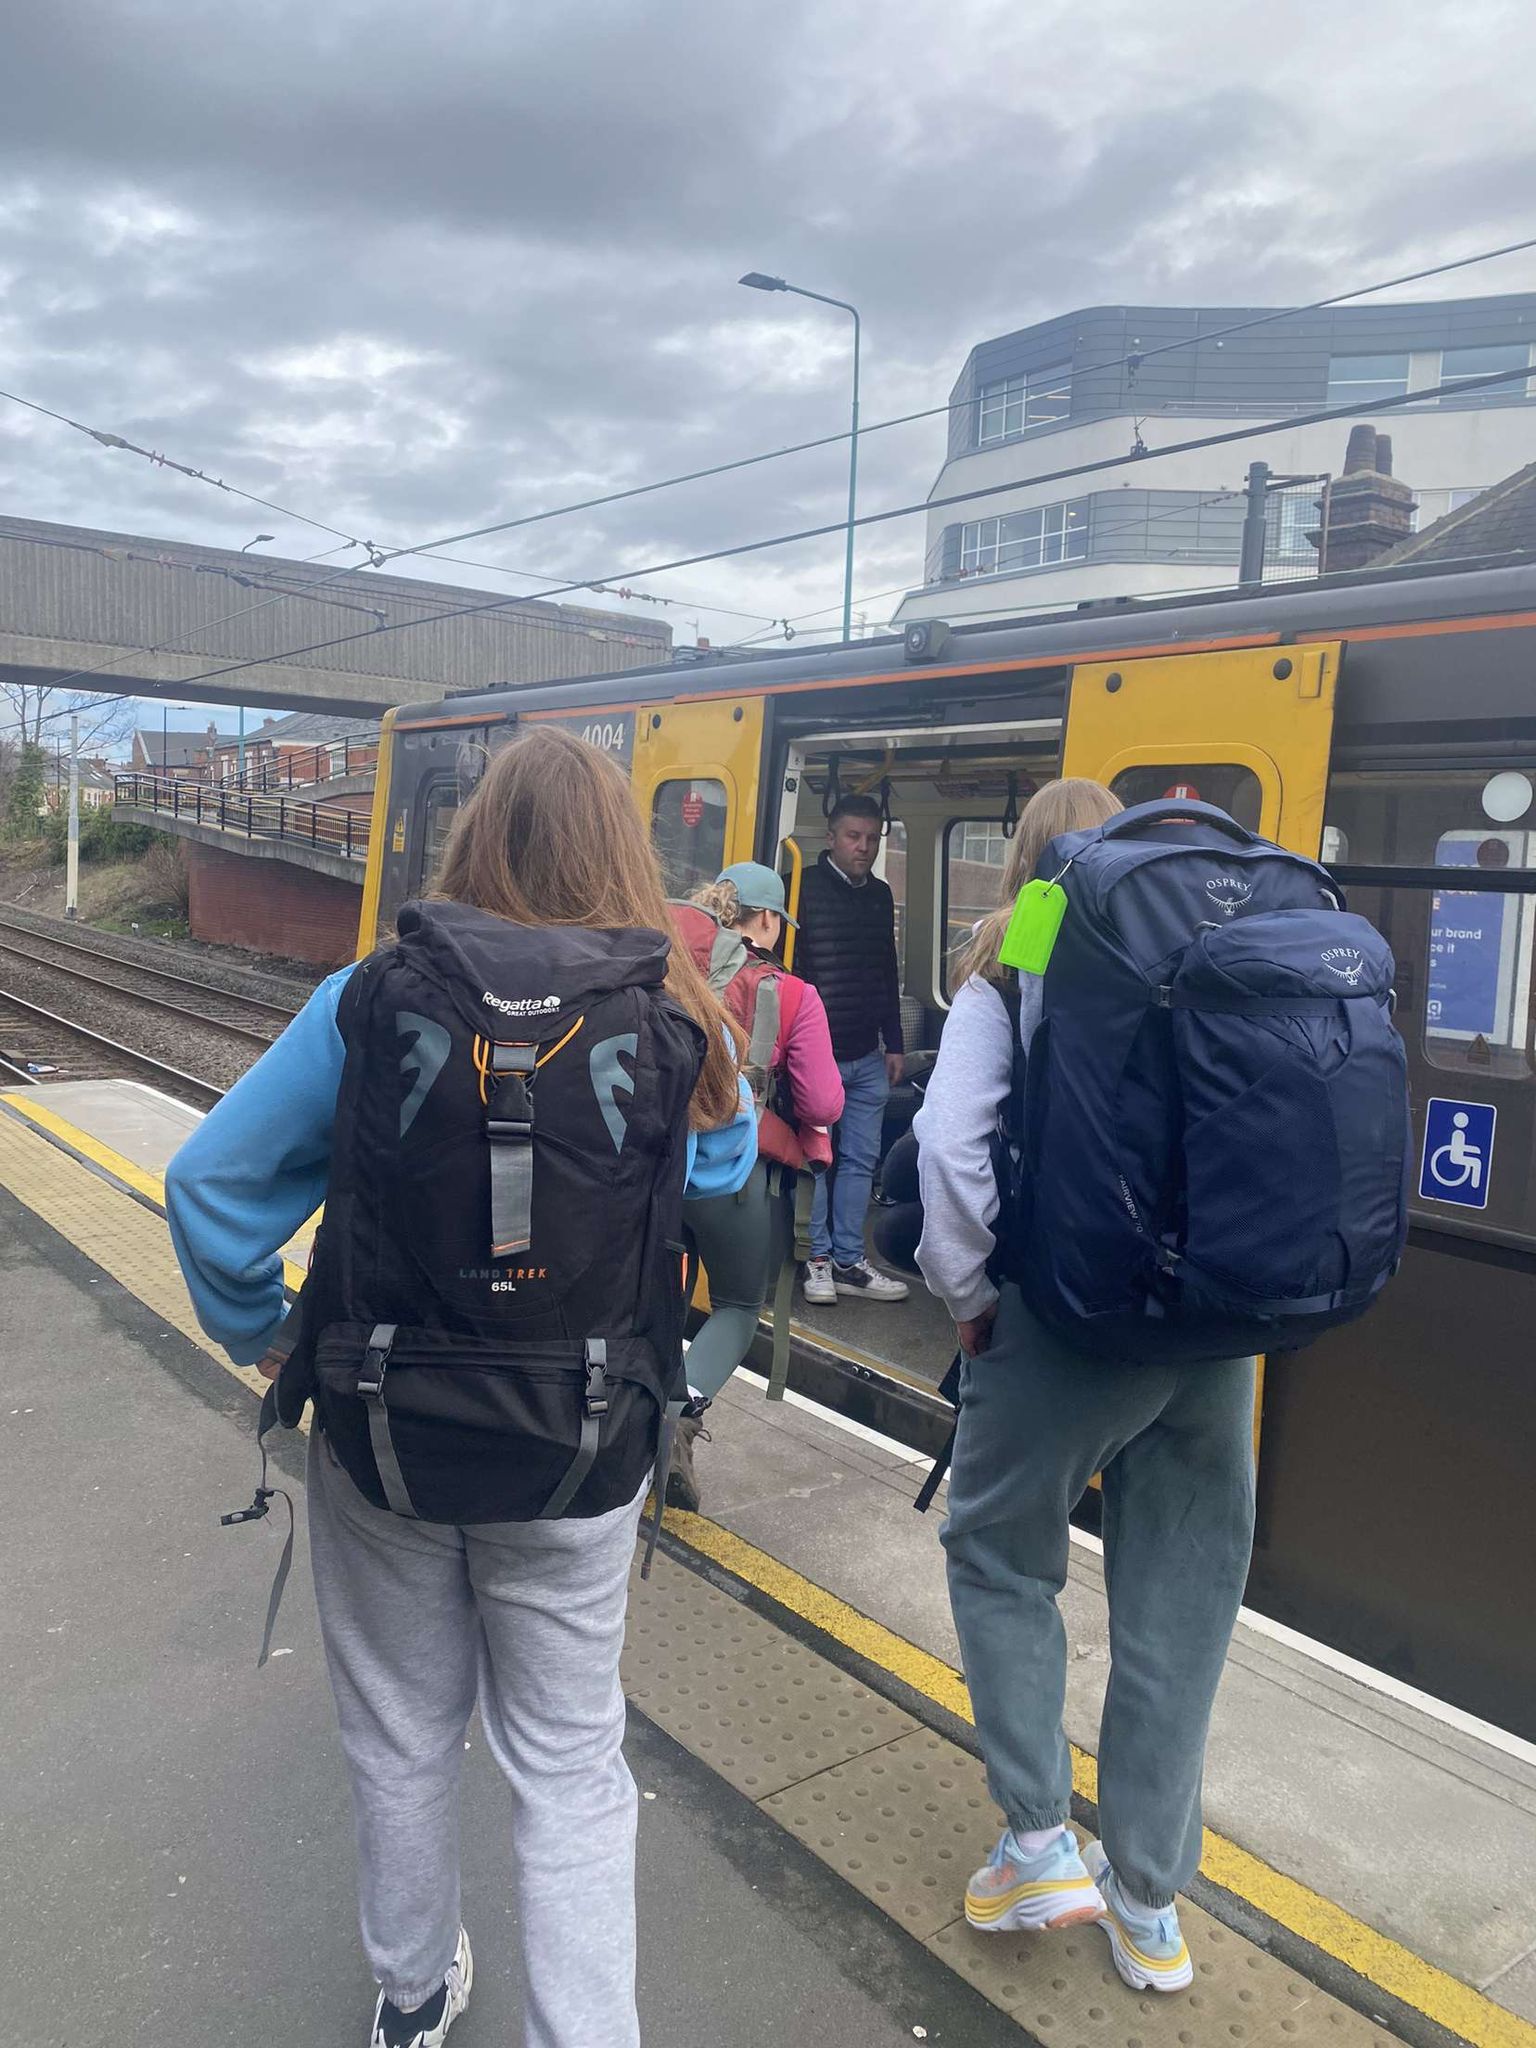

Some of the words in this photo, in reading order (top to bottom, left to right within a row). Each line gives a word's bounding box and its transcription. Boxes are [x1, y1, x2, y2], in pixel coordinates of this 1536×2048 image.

[581, 722, 624, 751] 4004
[1206, 877, 1251, 891] OSPREY
[1445, 927, 1482, 940] brand
[1320, 947, 1360, 961] OSPREY
[1447, 942, 1455, 953] it
[482, 991, 542, 1012] Regatta
[459, 1268, 500, 1279] LAND
[505, 1268, 548, 1279] TREK
[491, 1281, 517, 1292] 65L
